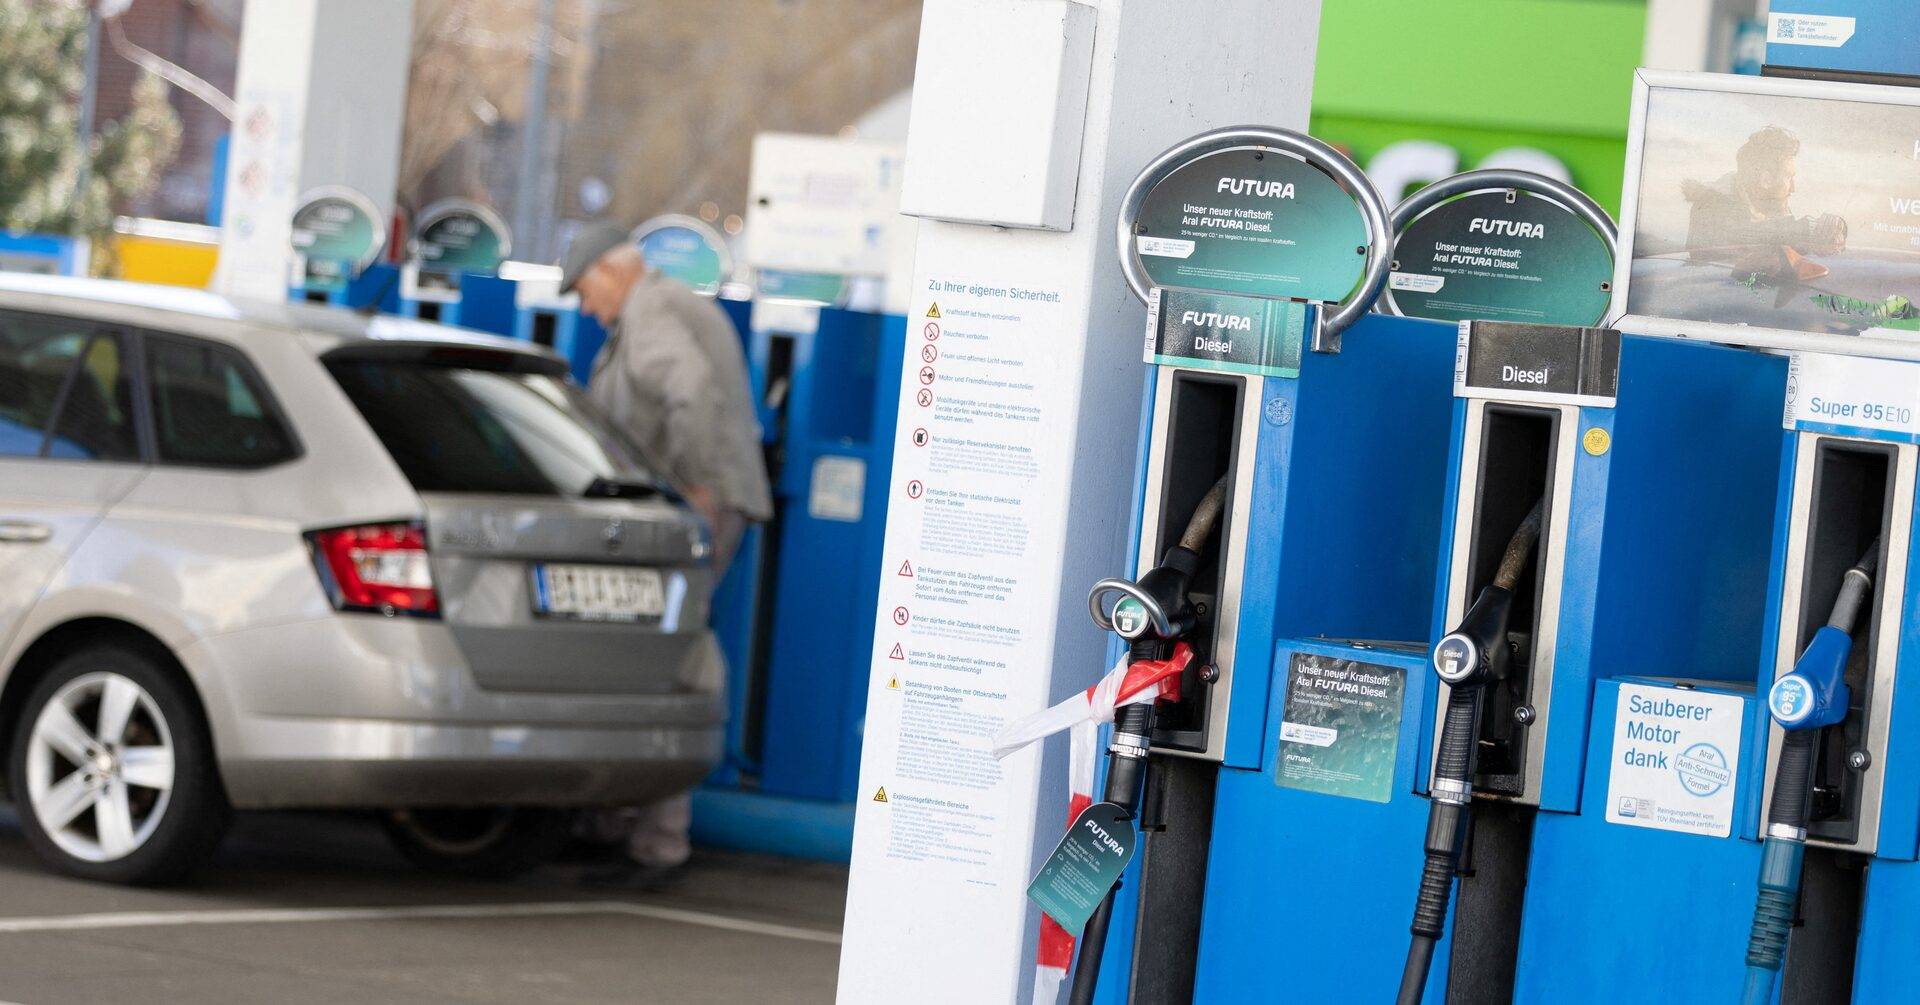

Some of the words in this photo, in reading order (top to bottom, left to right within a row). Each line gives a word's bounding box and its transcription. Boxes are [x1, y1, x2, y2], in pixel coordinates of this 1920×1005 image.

[1217, 177, 1295, 199] FUTURA
[1183, 204, 1207, 215] Unser
[1209, 207, 1232, 217] neuer
[1234, 207, 1273, 221] Kraftstoff:
[1182, 216, 1198, 226] Aral
[1200, 217, 1244, 230] FUTURA
[1245, 221, 1272, 232] Diesel.
[1469, 218, 1544, 239] FUTURA
[1890, 224, 1920, 233] unabh
[1435, 242, 1458, 252] Unser
[1460, 245, 1482, 255] neuer
[1484, 246, 1522, 259] Kraftstoff:
[1433, 252, 1449, 262] Aral
[1451, 255, 1492, 267] FUTURA
[1494, 259, 1519, 270] Diesel.
[929, 280, 940, 290] Zu
[944, 281, 966, 293] Ihrer
[969, 284, 1006, 297] eigenen
[1010, 287, 1060, 303] Sicherheit.
[946, 308, 969, 317] Kraftstoff
[1182, 311, 1250, 331] FUTURA
[944, 330, 964, 338] Rauchen
[1195, 337, 1231, 353] Diesel
[1001, 358, 1023, 366] verboten
[1502, 366, 1548, 384] Diesel
[1810, 397, 1858, 418] Super
[1863, 404, 1883, 420] 95
[1886, 406, 1910, 424] E10
[927, 488, 948, 496] Entladen
[918, 575, 947, 585] Tankstutzen
[959, 580, 985, 590] Fahrzeugs
[915, 593, 937, 601] Personal
[996, 626, 1020, 634] benutzen
[1444, 650, 1463, 658] Diesel
[908, 658, 928, 667] Tankens
[930, 660, 942, 668] nicht
[974, 658, 996, 667] während
[1298, 664, 1322, 675] Unser
[1325, 668, 1348, 679] neuer
[1350, 671, 1390, 686] Kraftstoff:
[905, 680, 932, 690] Betankung
[944, 685, 962, 694] Booten
[972, 689, 1007, 699] Ottokraftstoff
[1296, 676, 1312, 686] Aral
[1315, 679, 1358, 694] FUTURA
[1361, 685, 1388, 698] Diesel.
[1782, 681, 1801, 690] Super
[1783, 692, 1796, 702] 95
[1629, 694, 1712, 721] Sauberer
[1627, 721, 1680, 744] Motor
[1286, 755, 1311, 763] FUTURA
[1624, 748, 1668, 769] dank
[1699, 749, 1714, 760] Aral
[1677, 758, 1727, 781] Anti-Schmutz
[1687, 776, 1710, 791] Formel
[947, 801, 969, 810] Bereiche
[1657, 807, 1702, 819] Reinigungseffekt
[1657, 814, 1668, 823] TÜV
[1669, 817, 1696, 826] Rheinland
[1085, 820, 1124, 856] FUTURA
[1092, 840, 1106, 853] Diesel
